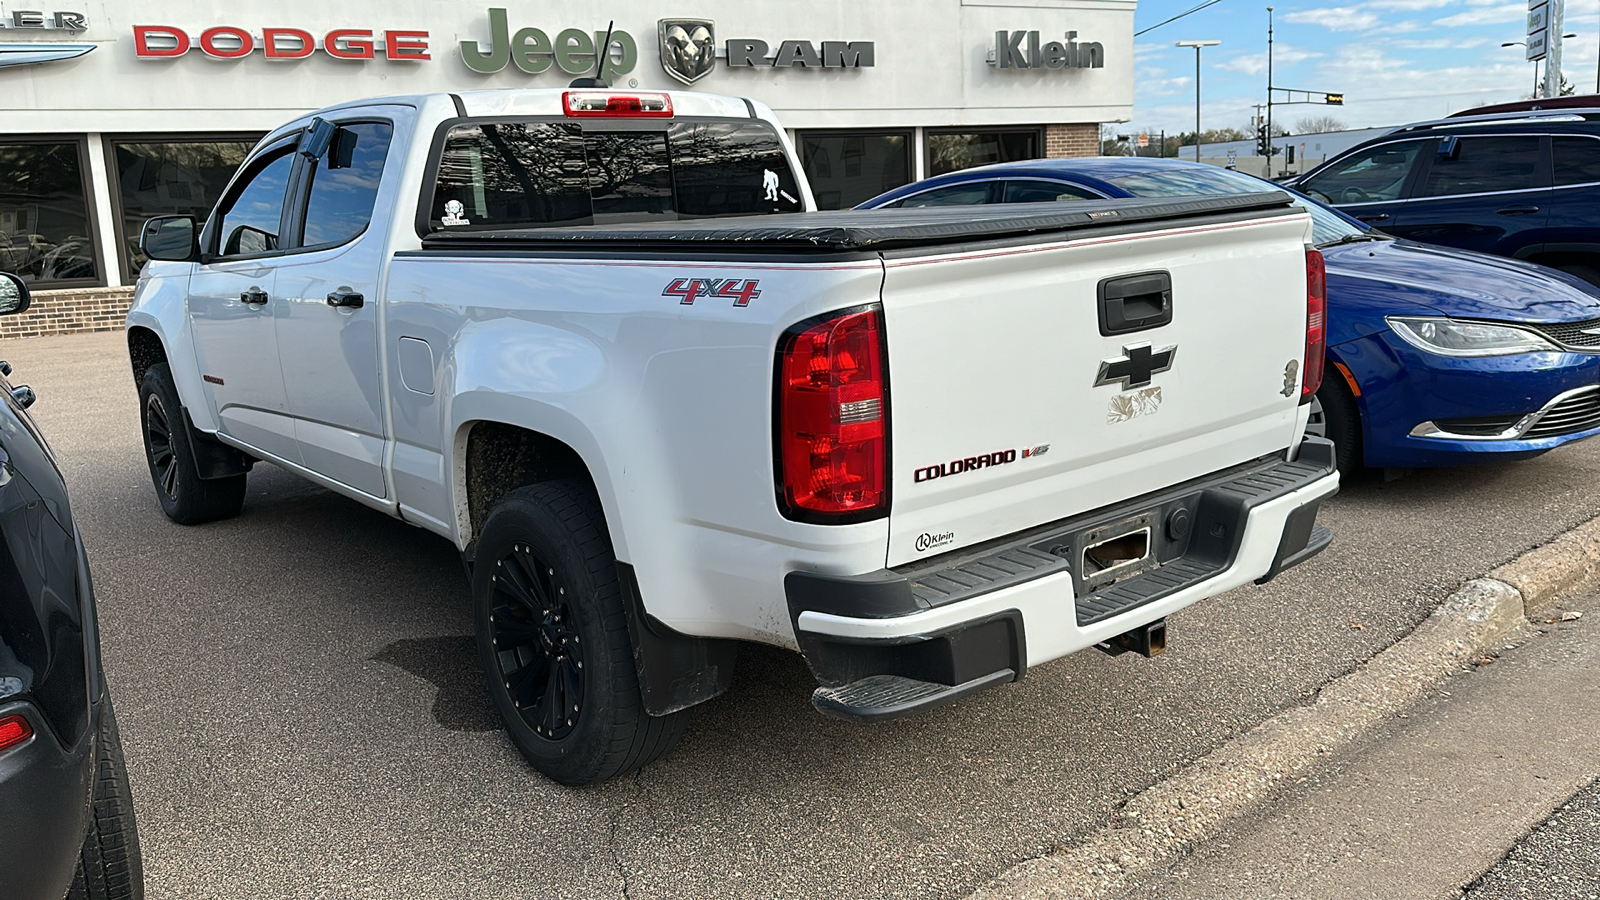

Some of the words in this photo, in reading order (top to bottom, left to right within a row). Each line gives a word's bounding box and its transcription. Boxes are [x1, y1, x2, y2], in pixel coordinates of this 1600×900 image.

[132, 24, 432, 61] DODGE
[459, 7, 638, 87] Jeep
[725, 38, 875, 67] RAM
[995, 30, 1104, 69] Klein
[913, 449, 1016, 483] COLORADO
[931, 531, 954, 544] Klein
